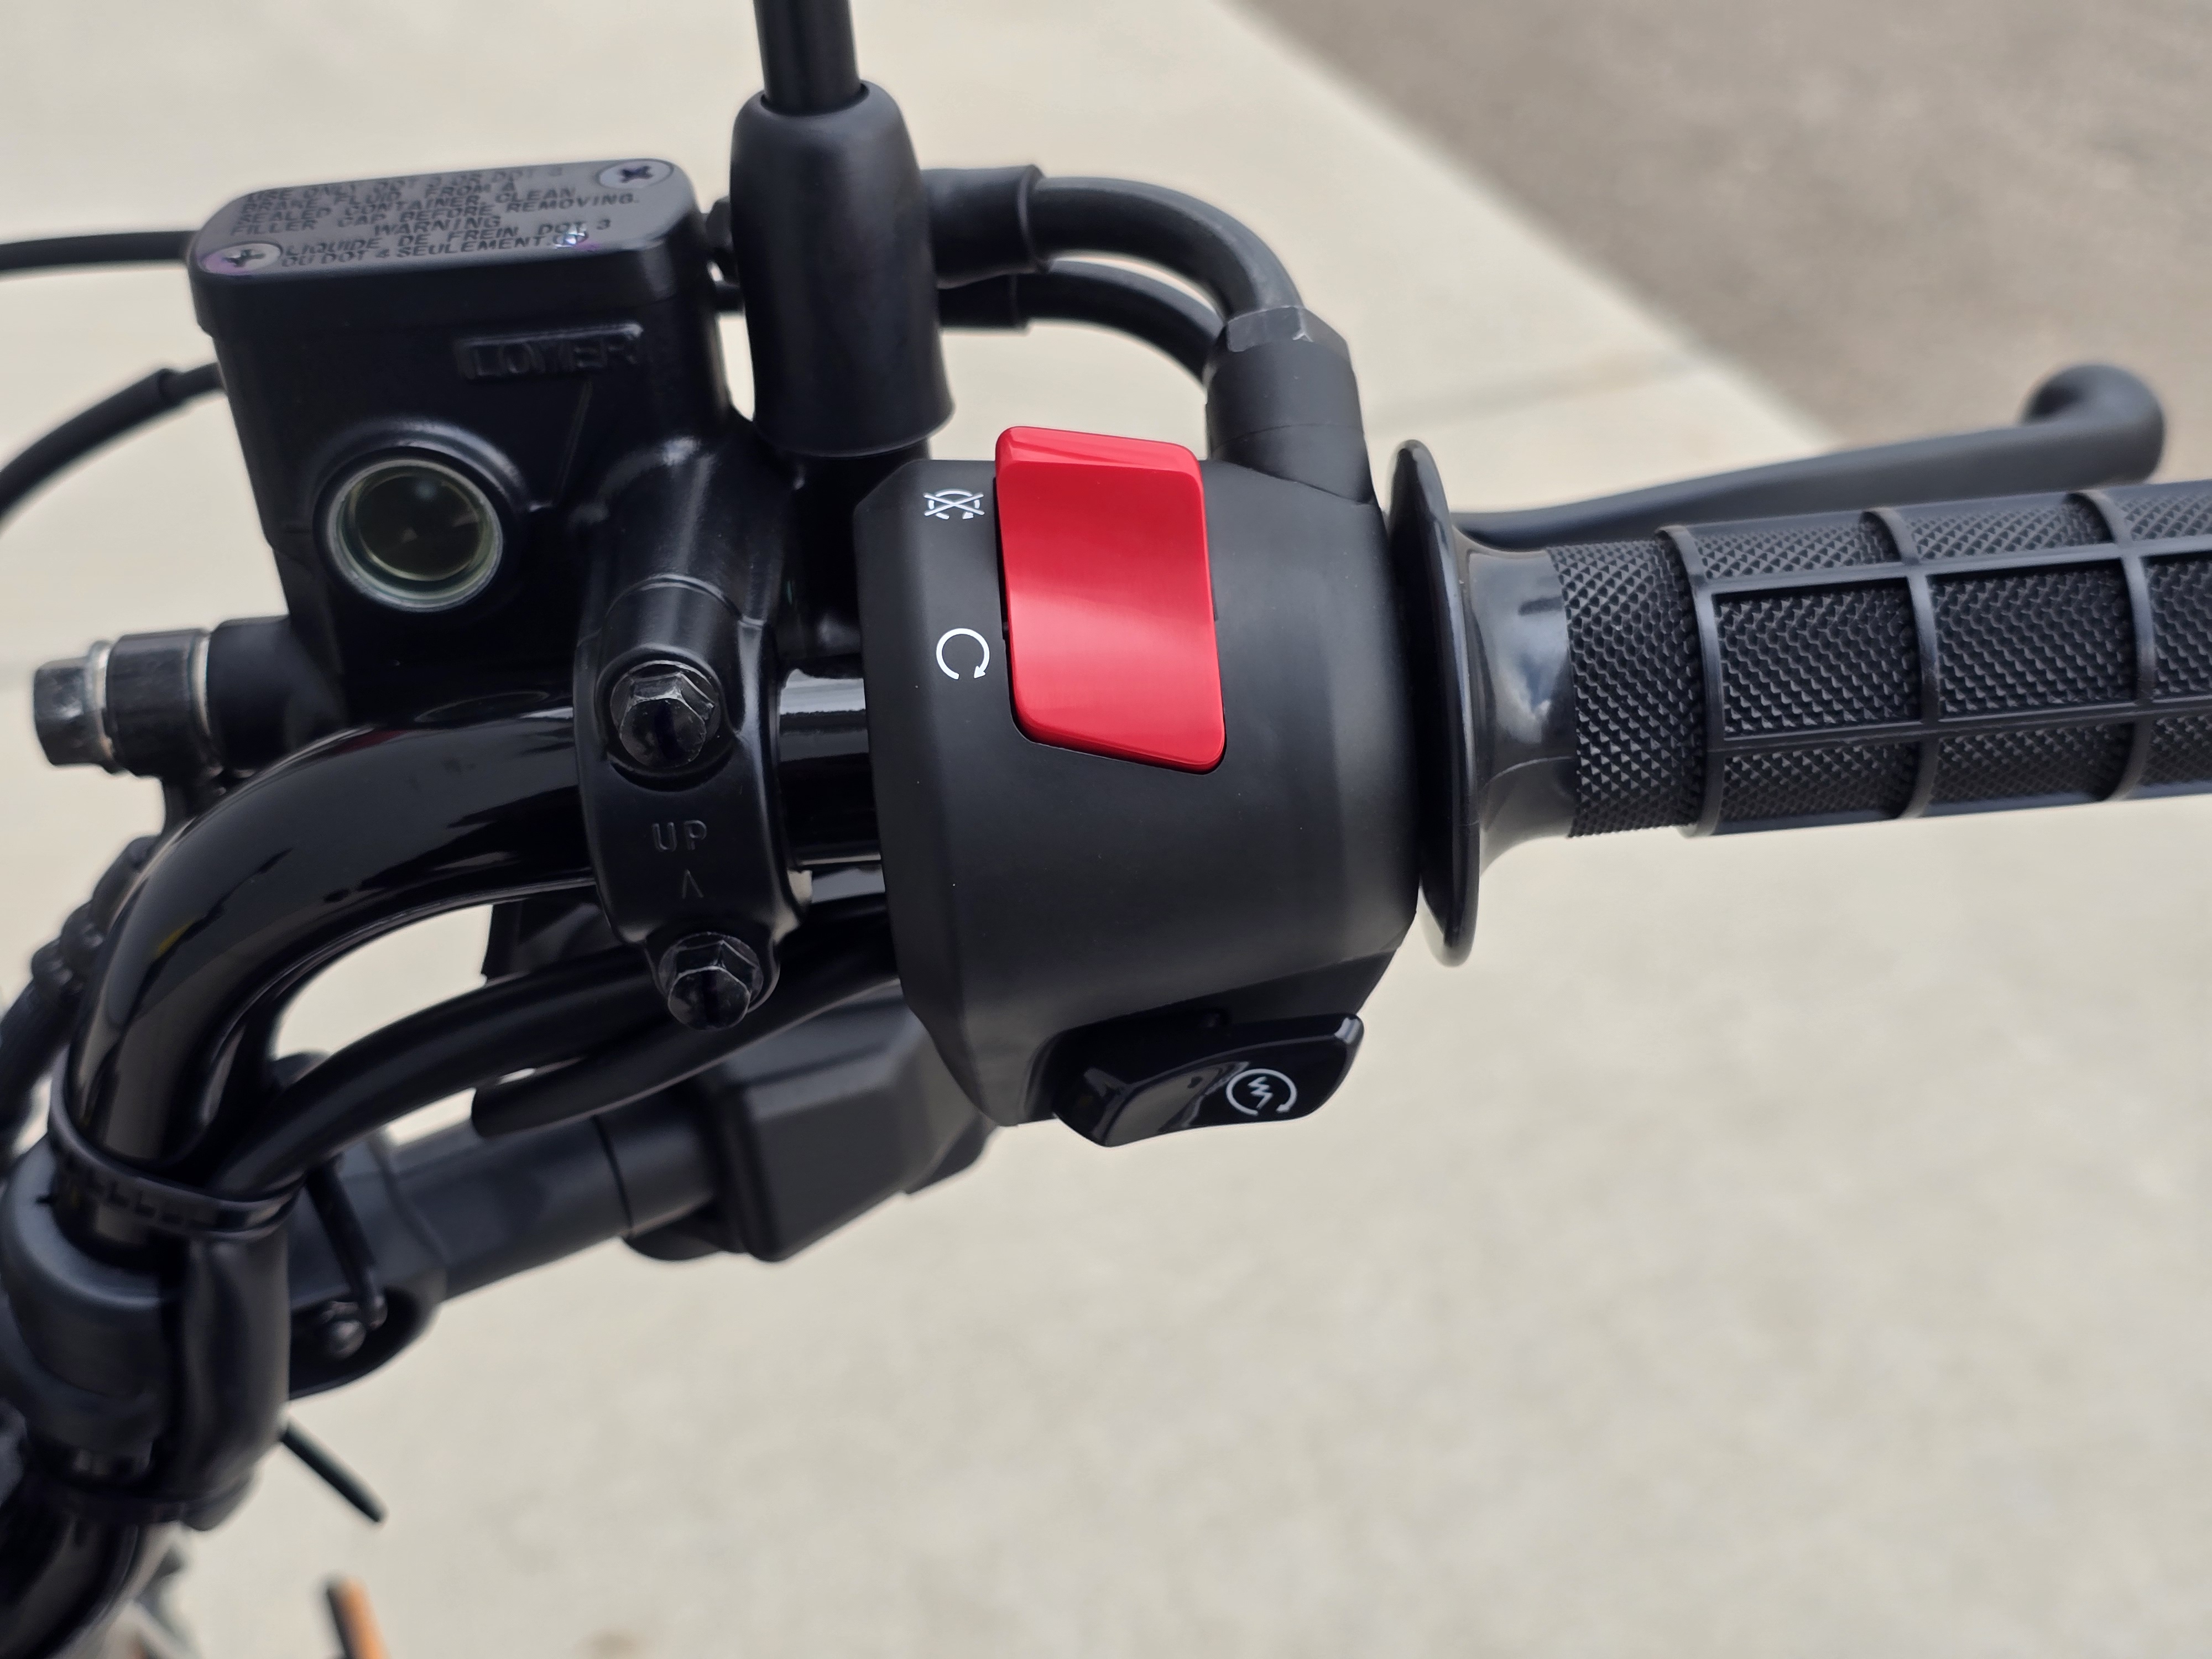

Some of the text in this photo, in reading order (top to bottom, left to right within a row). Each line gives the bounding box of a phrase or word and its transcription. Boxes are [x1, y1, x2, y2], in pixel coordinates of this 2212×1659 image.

[238, 207, 332, 225] SEALED
[495, 187, 576, 203] CLEAN
[334, 191, 401, 206] FLUID
[425, 184, 492, 199] FROM
[501, 181, 517, 192] A
[229, 220, 319, 236] FILLER
[337, 213, 387, 227] CAP
[399, 205, 495, 222] BEFORE
[284, 216, 612, 256] LIQUIDE DE FREIN DOT 3
[373, 216, 501, 236] WARNING
[281, 254, 312, 267] OU
[320, 249, 368, 264] DOT
[375, 248, 389, 259] 4
[651, 820, 707, 852] UP
